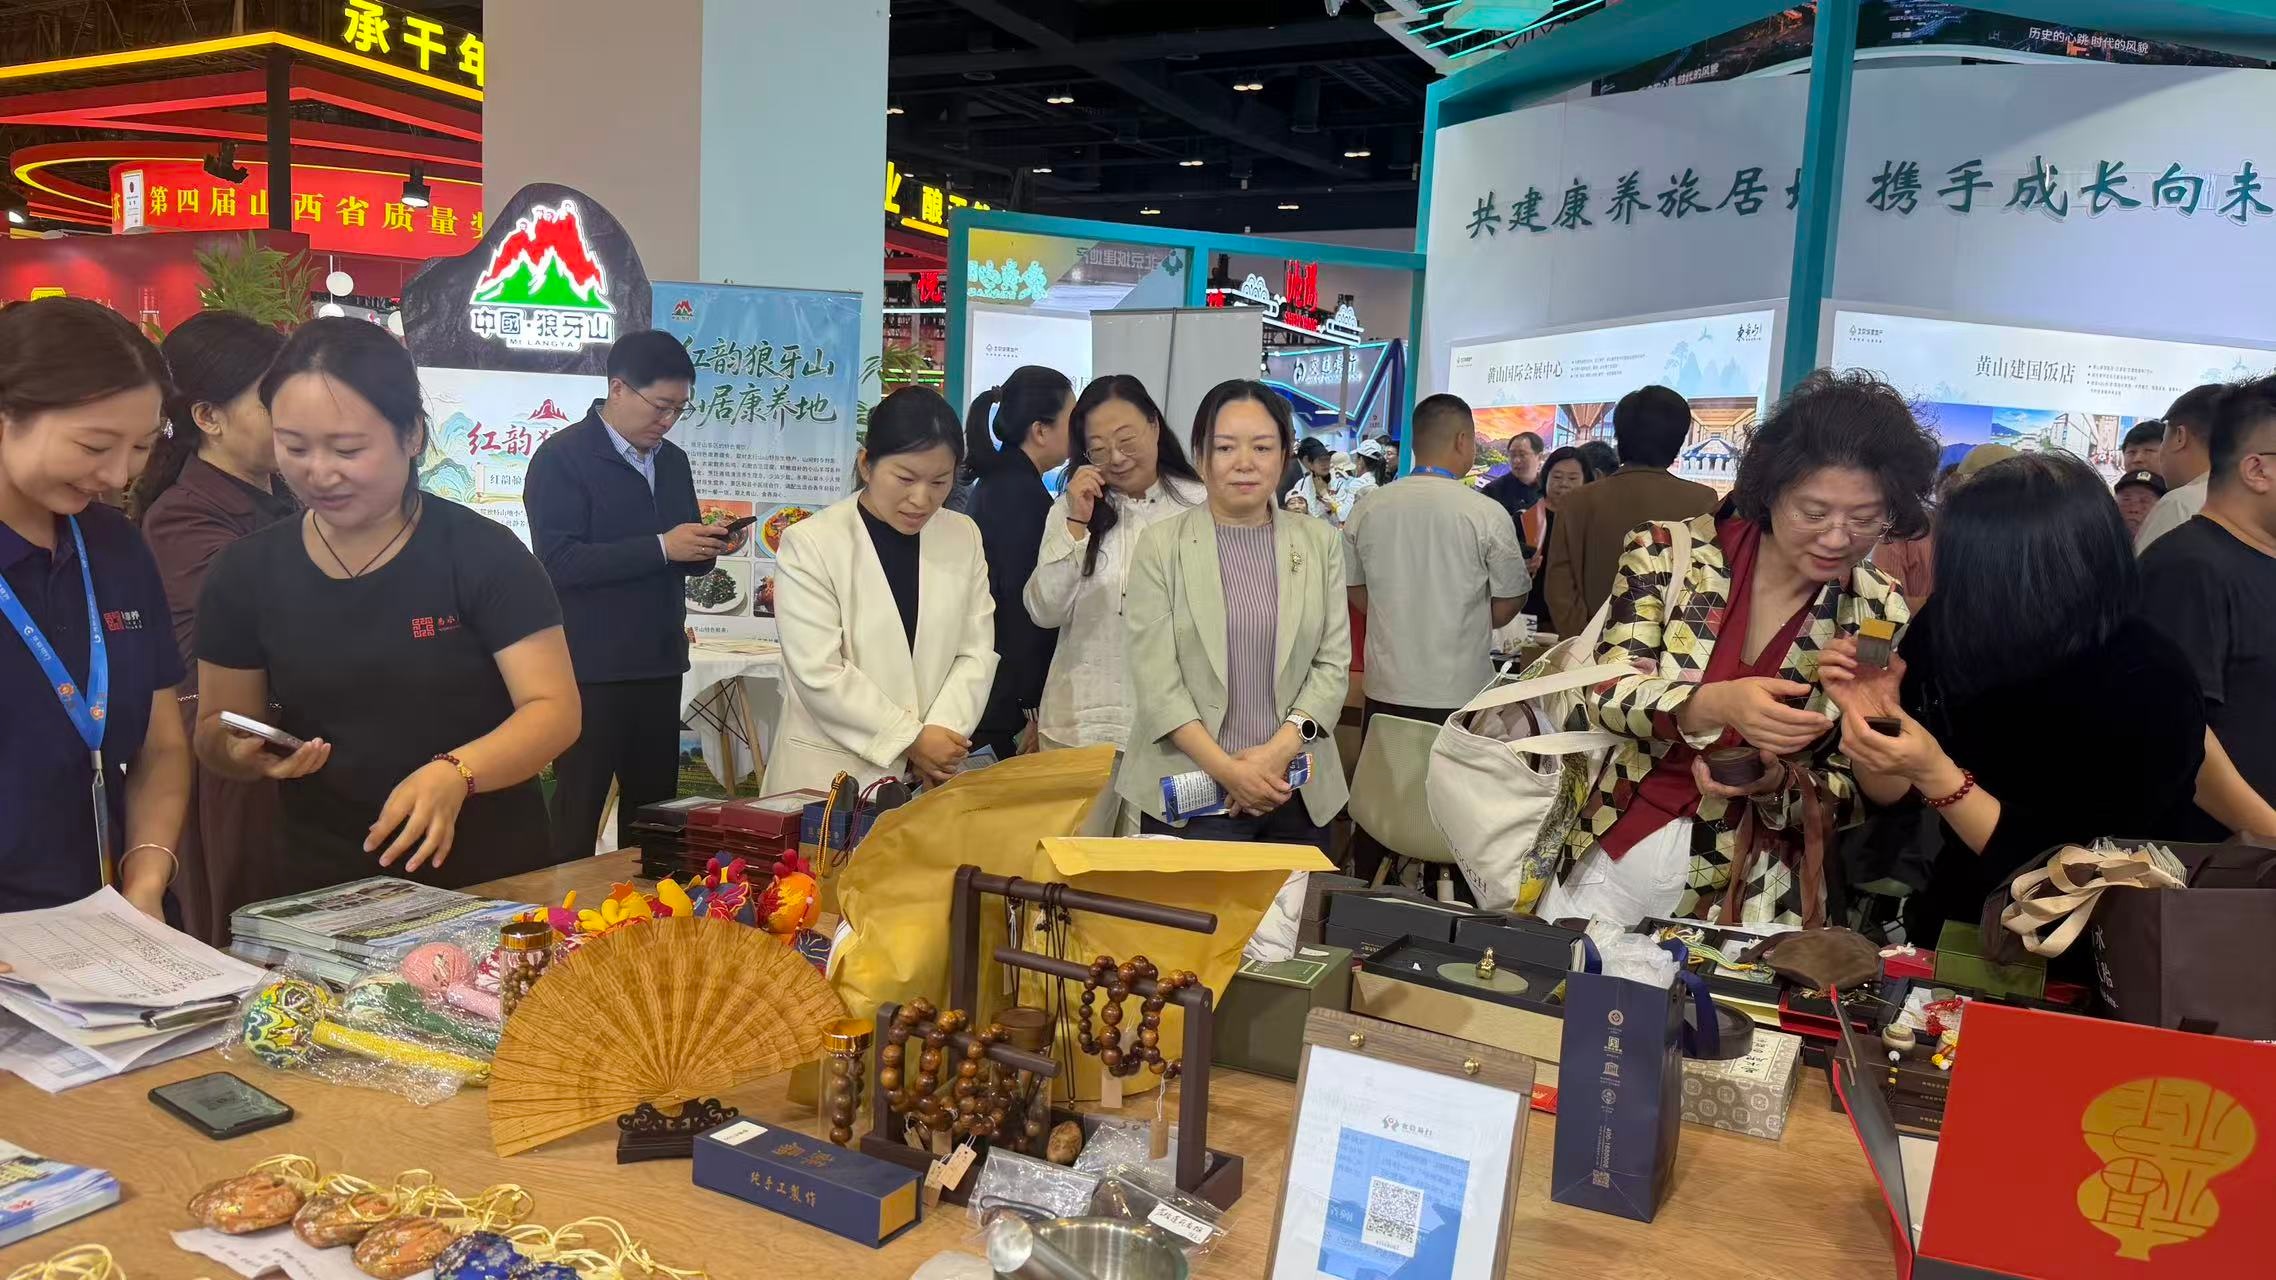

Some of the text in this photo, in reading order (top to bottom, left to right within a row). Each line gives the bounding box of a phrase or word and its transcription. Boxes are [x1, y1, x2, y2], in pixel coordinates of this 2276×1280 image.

[2029, 27, 2149, 55] 历史的心跳 时代的风貌
[1866, 155, 2274, 224] 携手成长向未
[1486, 360, 1564, 385] 黄山国际会展中心
[1974, 354, 2077, 385] 黄山建国饭店
